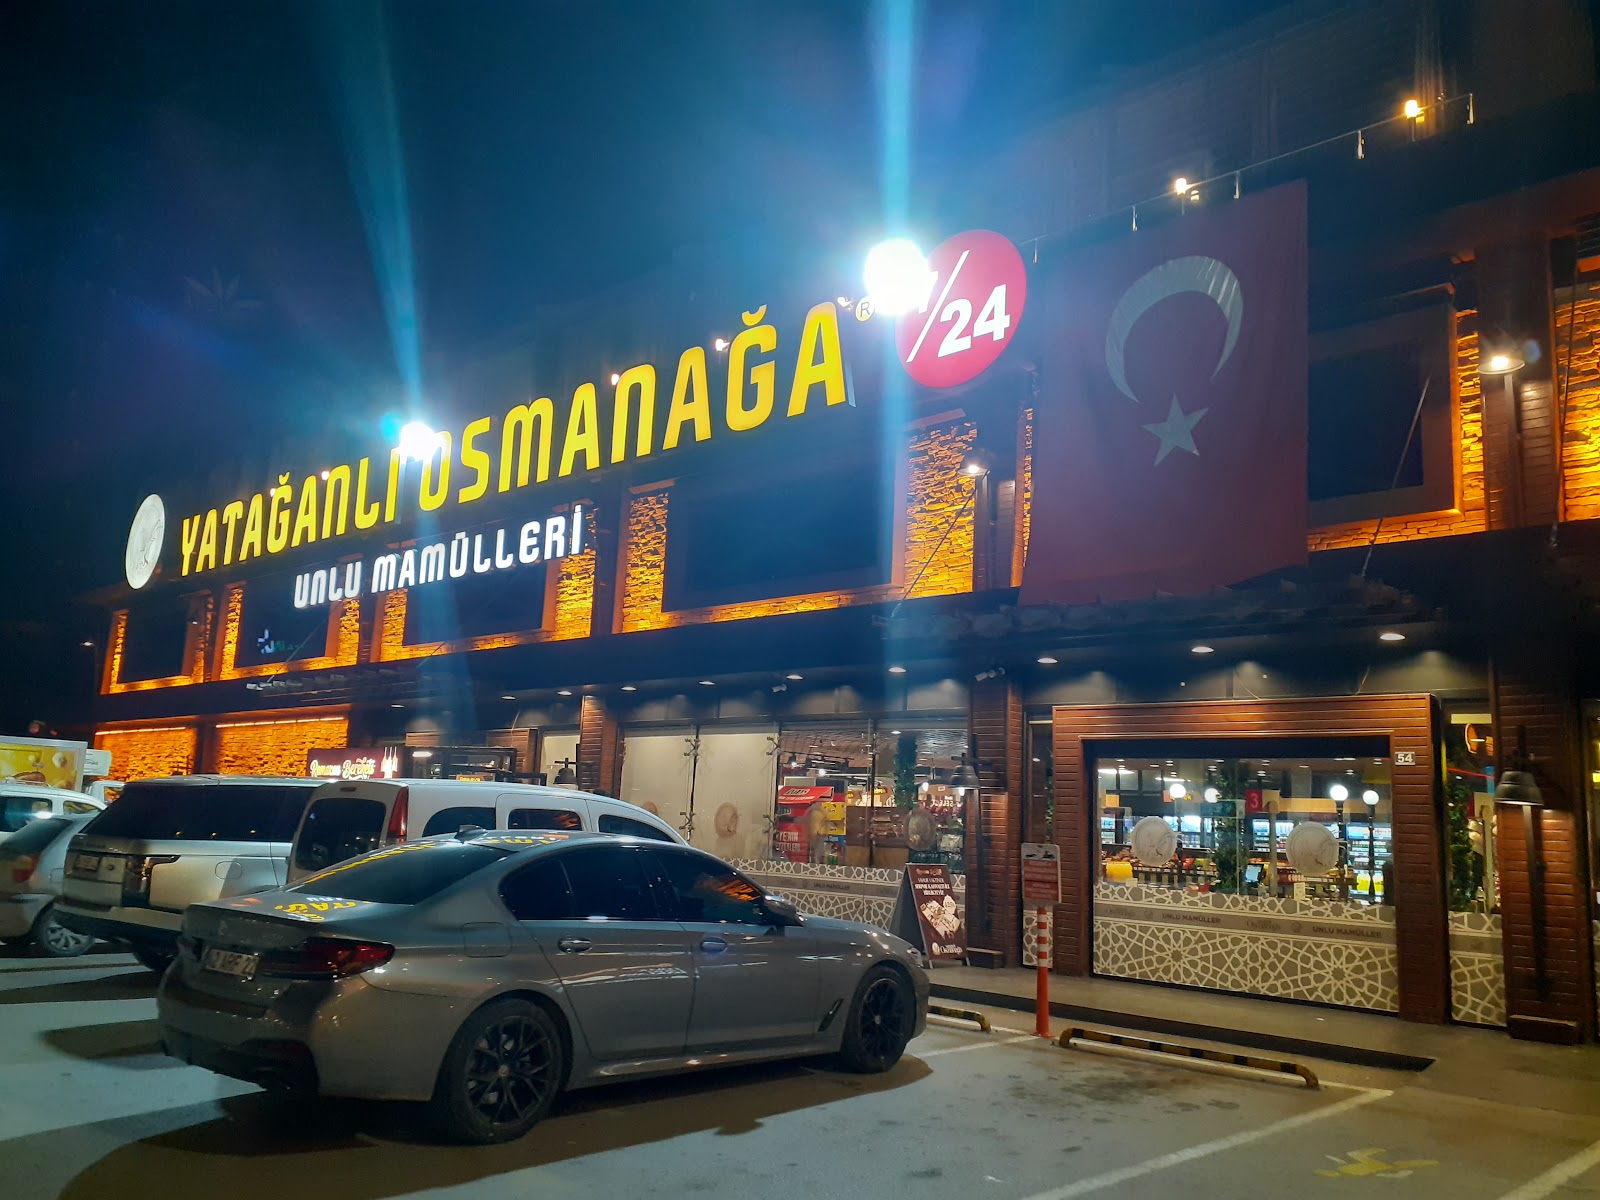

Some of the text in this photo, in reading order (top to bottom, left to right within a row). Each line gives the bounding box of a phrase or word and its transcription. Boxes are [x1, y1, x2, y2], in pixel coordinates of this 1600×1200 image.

[418, 301, 847, 512] OSMANAĞA
[293, 504, 582, 609] UNLU MAMÜLLERİ
[1397, 753, 1413, 763] 54
[1249, 791, 1260, 808] 3
